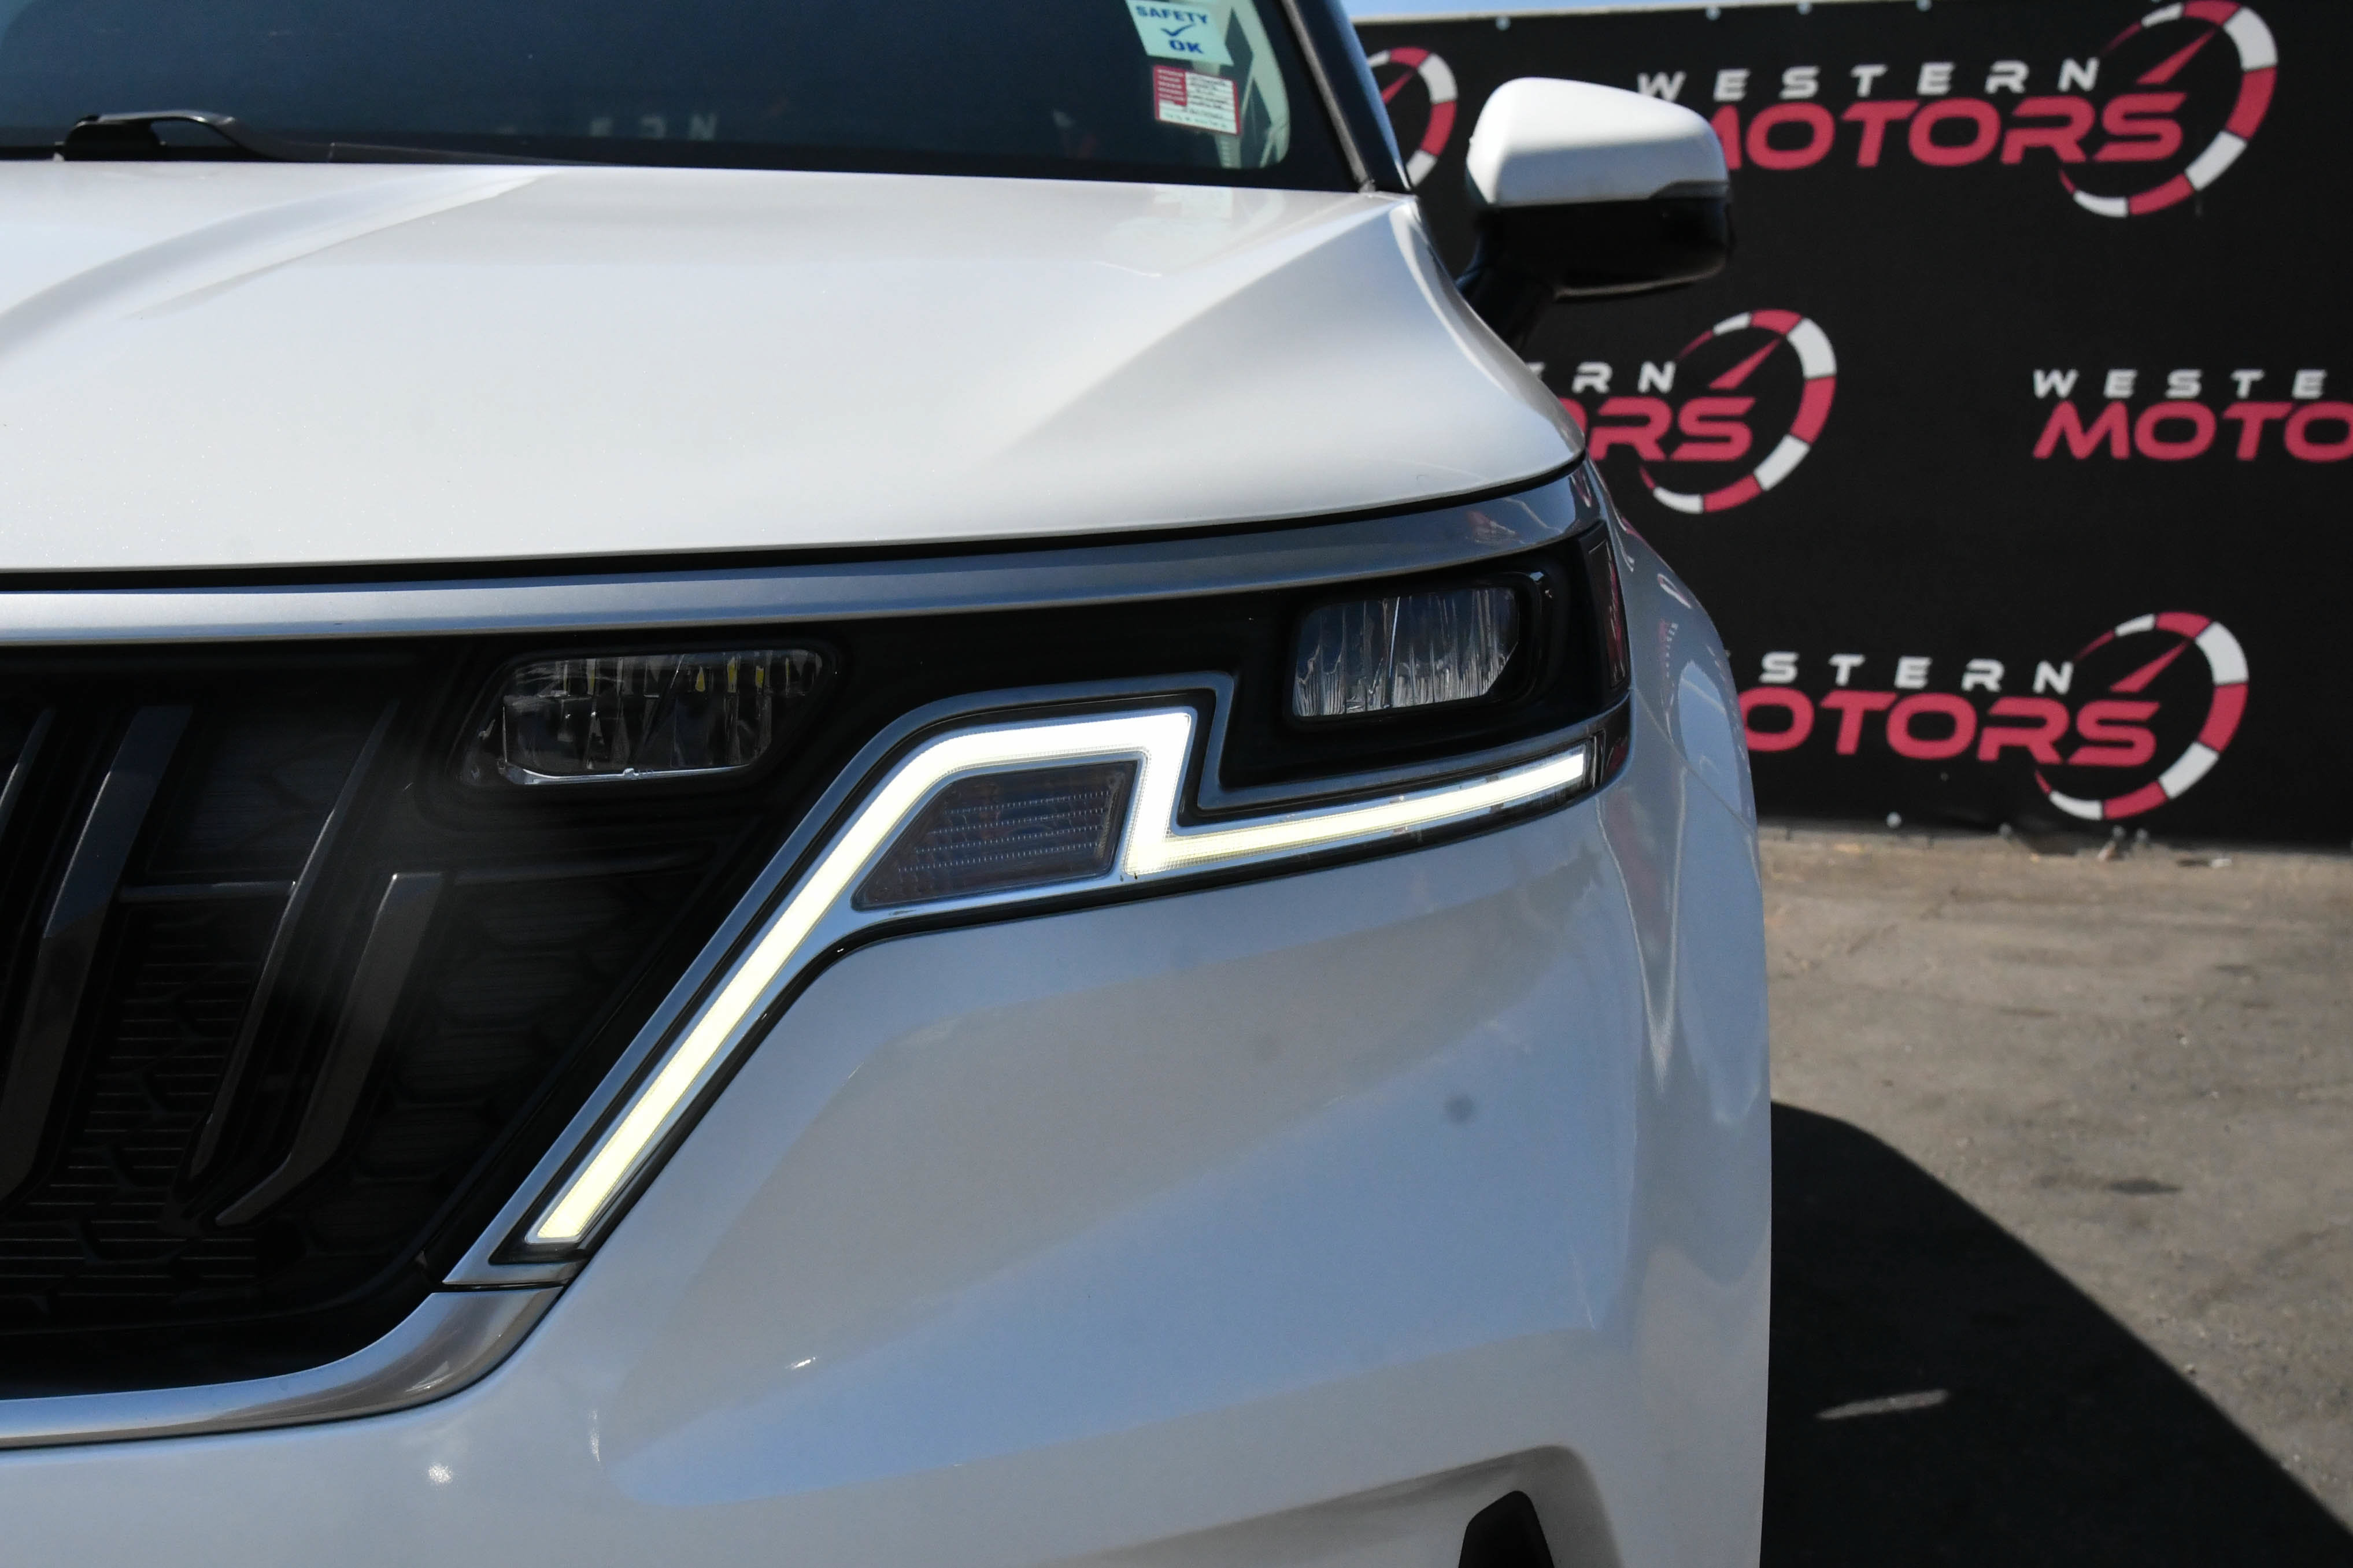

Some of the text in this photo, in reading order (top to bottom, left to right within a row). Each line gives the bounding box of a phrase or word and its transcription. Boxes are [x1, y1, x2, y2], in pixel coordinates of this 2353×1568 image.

[1135, 5, 1208, 24] SAFETY
[1169, 39, 1204, 54] OK
[1637, 57, 2100, 102] WESTERN
[1524, 361, 1676, 394] RN
[2033, 369, 2327, 399] WESTE
[2032, 400, 2353, 462] MOTO
[1725, 650, 2074, 694] STERN
